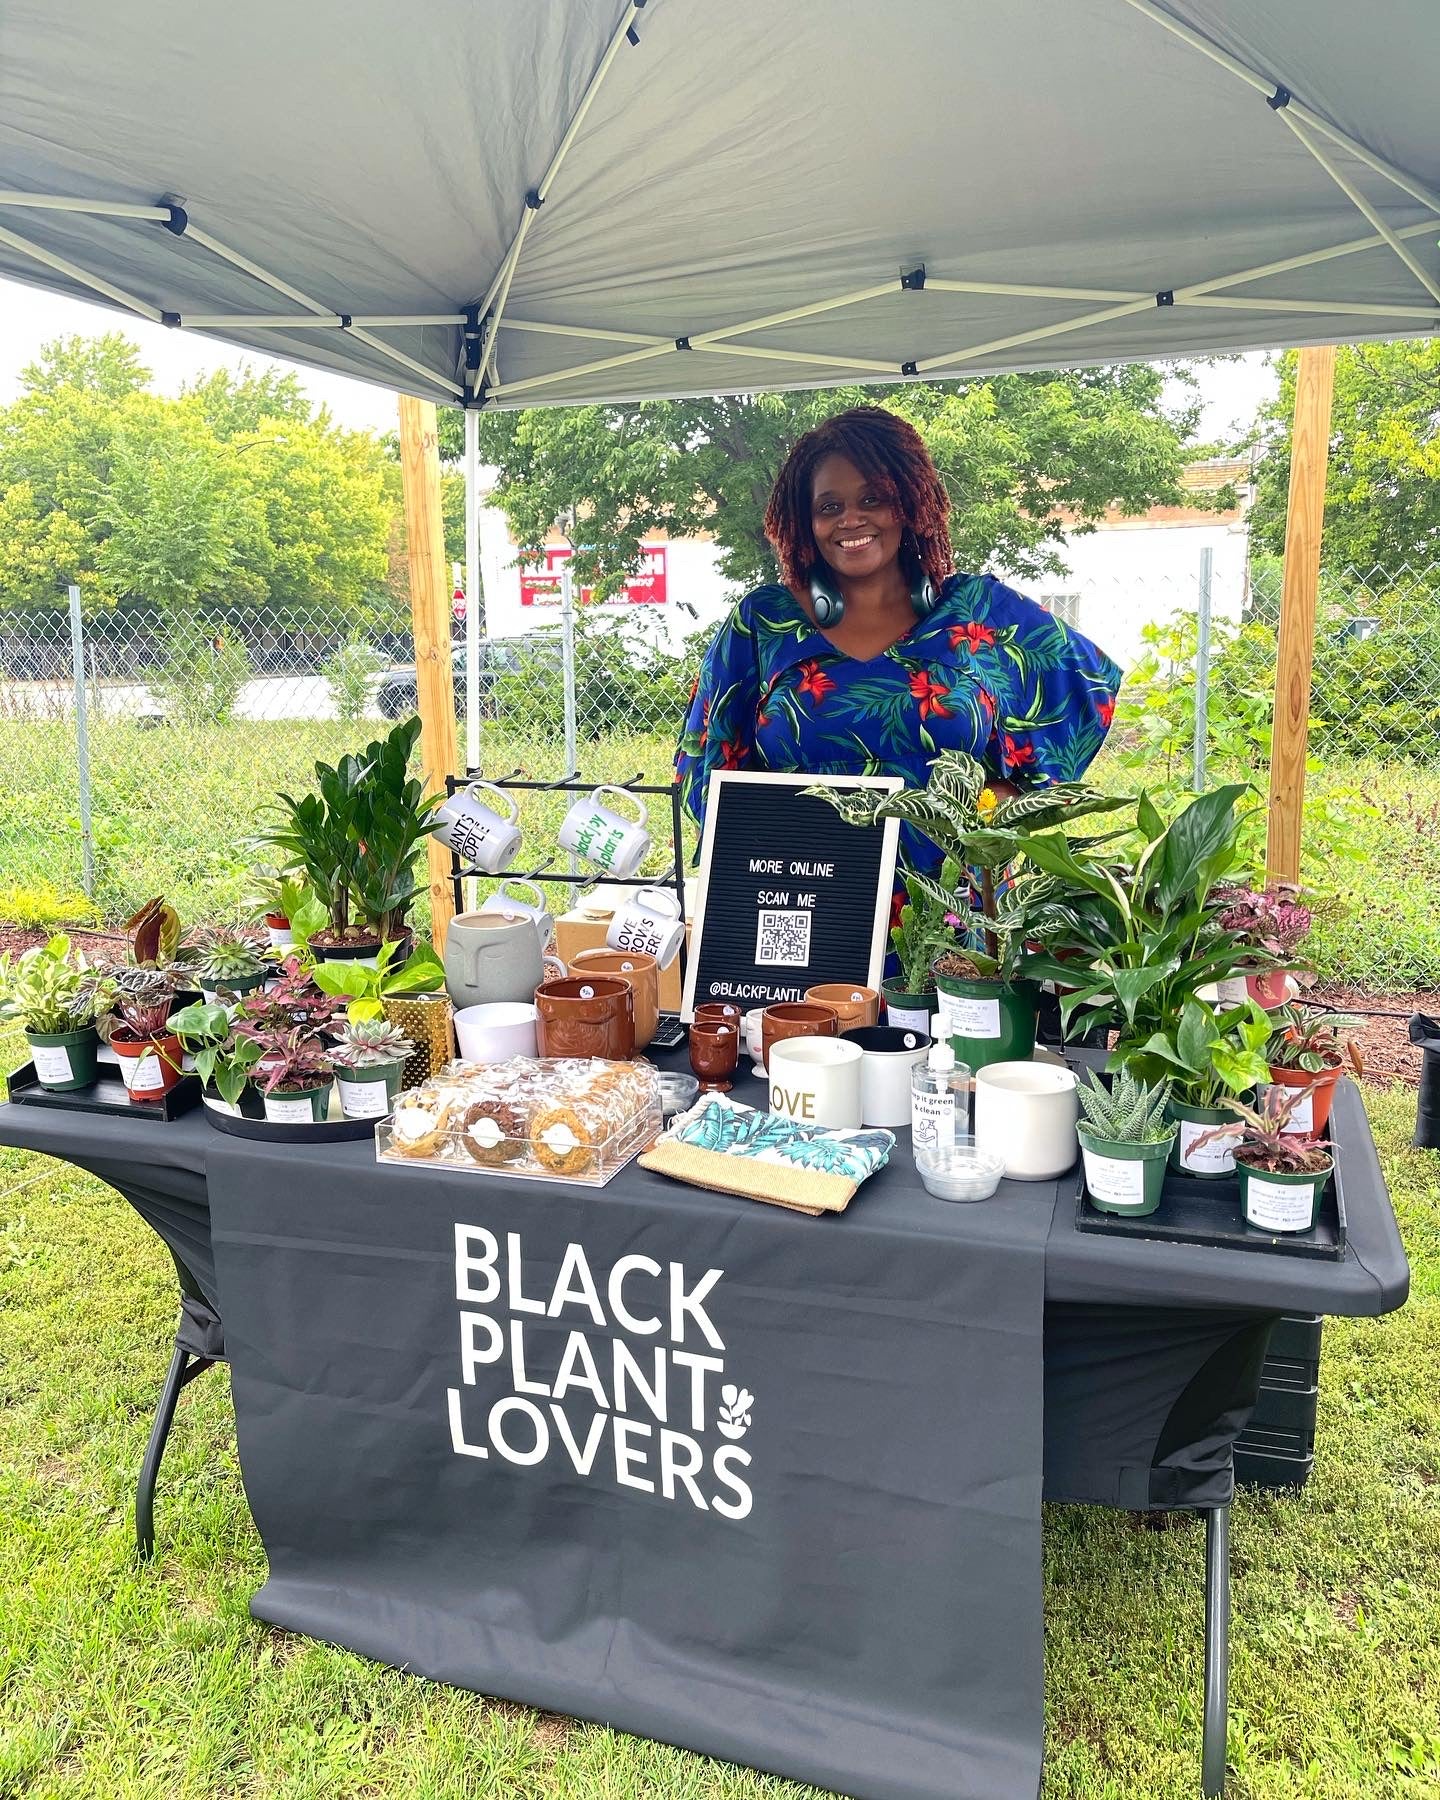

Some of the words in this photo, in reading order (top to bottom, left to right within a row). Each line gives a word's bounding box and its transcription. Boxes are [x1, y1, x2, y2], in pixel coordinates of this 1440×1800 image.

[749, 859, 783, 874] MORE
[790, 862, 834, 877] ONLINE
[757, 891, 789, 905] SCAN
[797, 894, 816, 907] ME
[769, 1085, 816, 1119] OVE
[919, 1106, 941, 1115] clean
[928, 1098, 954, 1106] green
[454, 1222, 726, 1350] BLACK
[460, 1310, 724, 1432] PLANT
[447, 1387, 753, 1520] LOVERS
